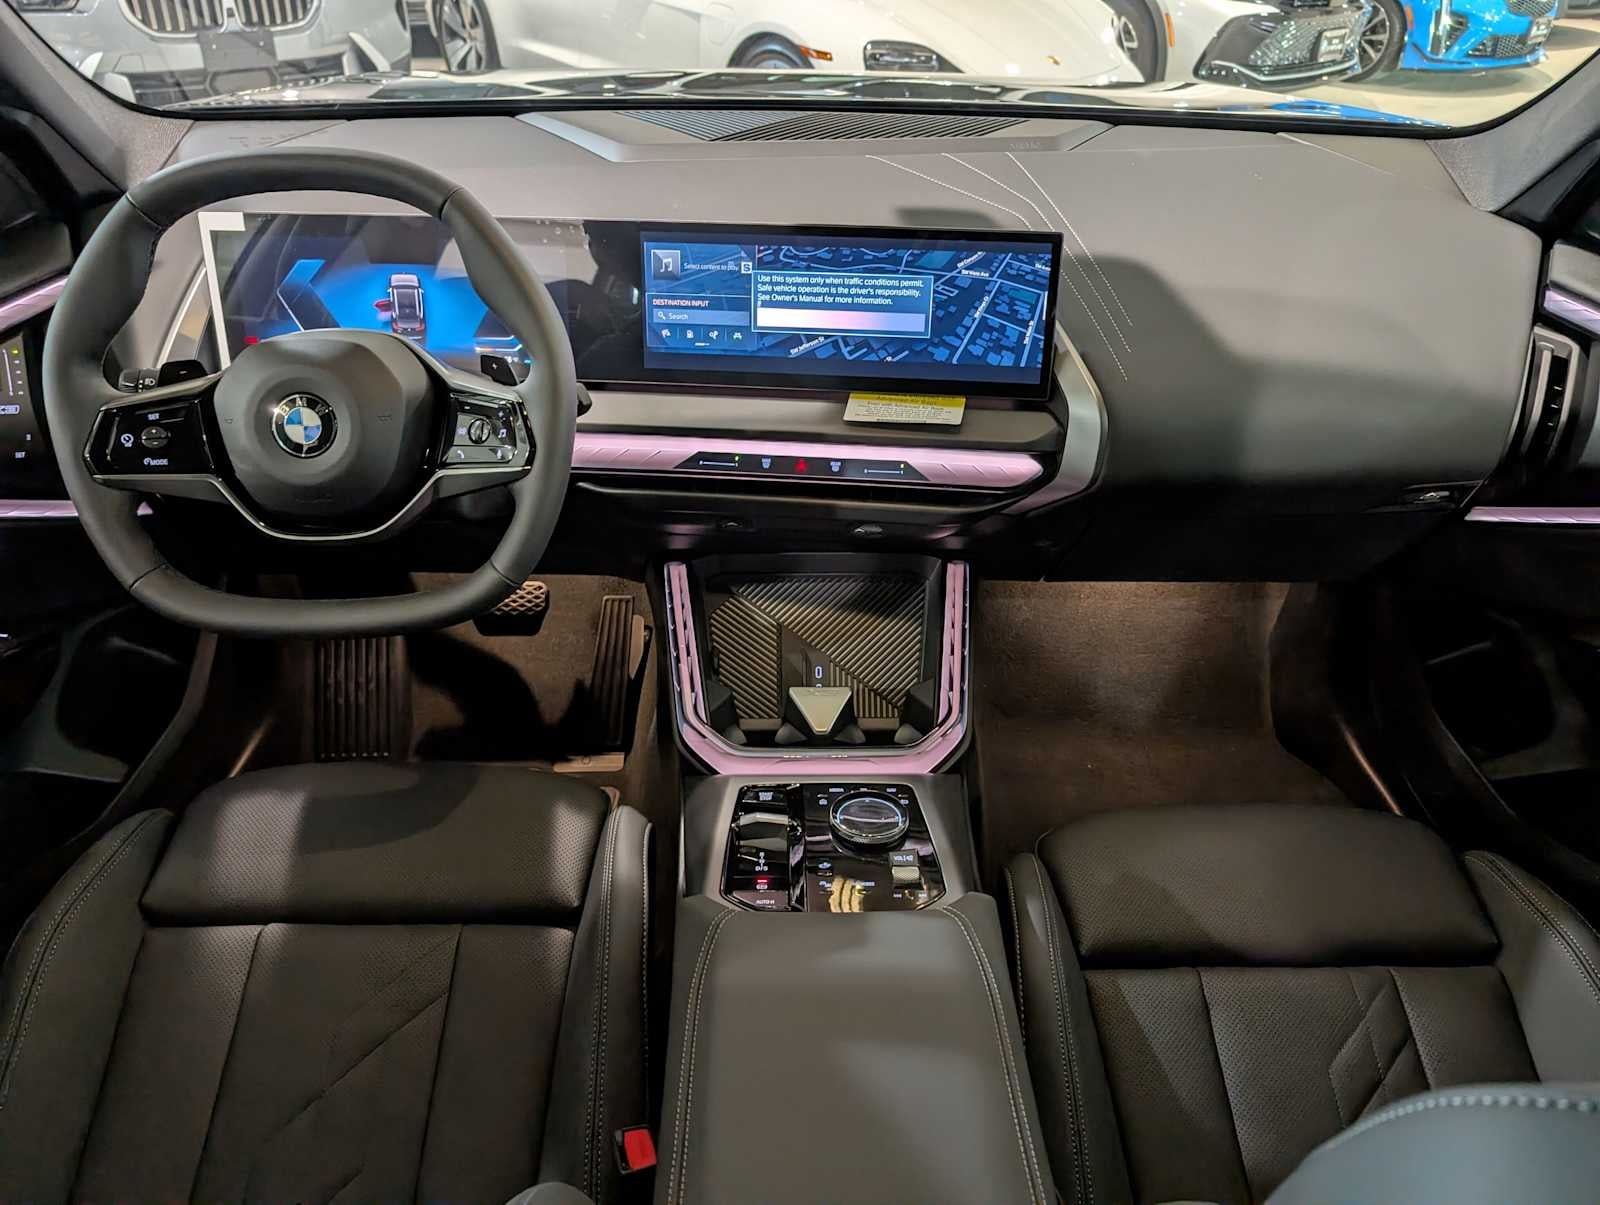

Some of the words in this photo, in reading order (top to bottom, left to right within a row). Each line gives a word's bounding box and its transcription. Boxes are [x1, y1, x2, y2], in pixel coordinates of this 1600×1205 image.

[758, 274, 771, 283] Use
[771, 275, 784, 283] this
[785, 276, 809, 285] system
[809, 277, 825, 286] only
[825, 277, 844, 285] when
[844, 277, 863, 286] traffic
[864, 279, 899, 287] conditions
[900, 280, 924, 288] permit.
[757, 283, 772, 292] Safe
[773, 284, 797, 293] vehicle
[797, 286, 829, 294] operation
[830, 286, 837, 294] is
[837, 286, 849, 294] the
[849, 287, 874, 296] driver's
[875, 288, 921, 298] responsibility.
[653, 298, 690, 307] DESTINATION
[757, 293, 770, 301] See
[771, 293, 798, 302] Owner's
[799, 294, 824, 303] Manual
[824, 295, 834, 303] for
[834, 296, 853, 304] more
[853, 296, 893, 305] information.
[668, 312, 688, 320] Search
[279, 397, 329, 416] BMW
